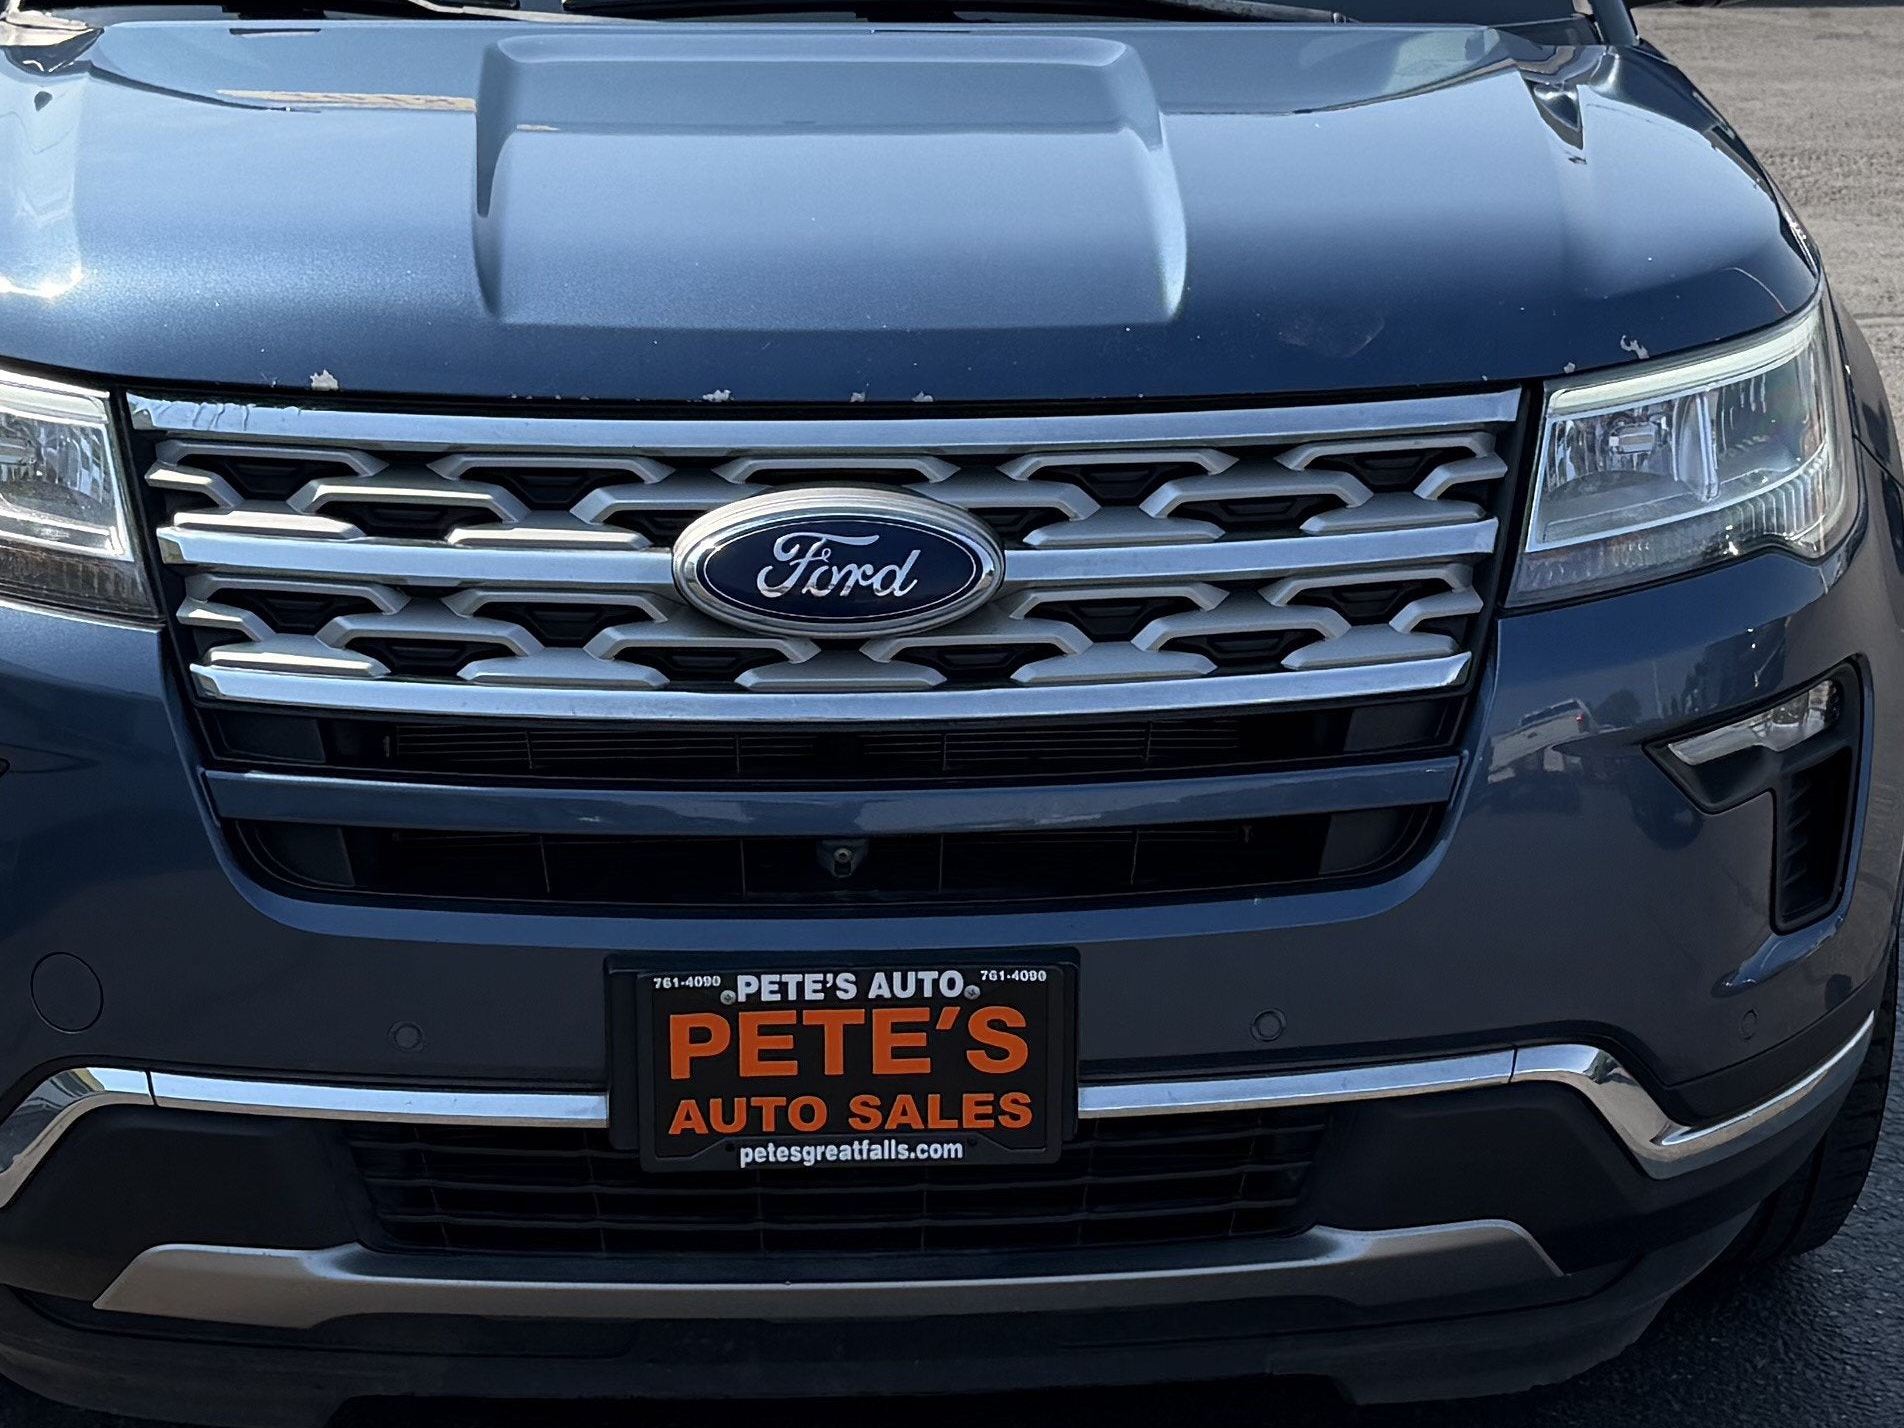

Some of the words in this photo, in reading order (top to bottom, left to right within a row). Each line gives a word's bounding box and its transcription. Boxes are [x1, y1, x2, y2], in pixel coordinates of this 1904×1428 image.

[756, 531, 922, 599] Ford
[737, 972, 857, 1002] PETE'S
[868, 970, 964, 999] AUTO
[669, 1006, 1029, 1079] PETE'S
[668, 1096, 828, 1134] AUTO
[848, 1092, 1033, 1129] SALES
[740, 1139, 964, 1168] petesgreatfalls.com
